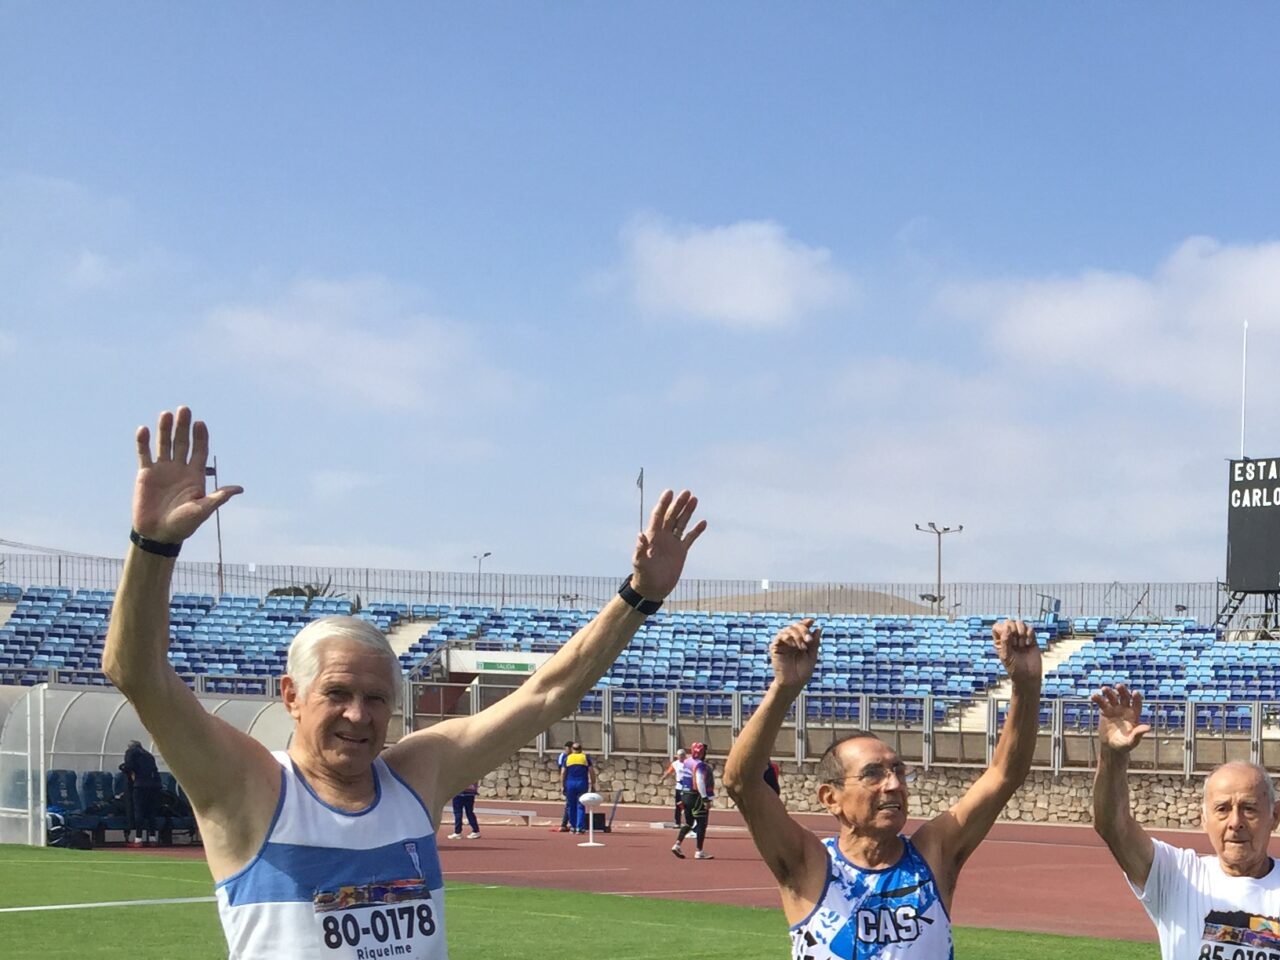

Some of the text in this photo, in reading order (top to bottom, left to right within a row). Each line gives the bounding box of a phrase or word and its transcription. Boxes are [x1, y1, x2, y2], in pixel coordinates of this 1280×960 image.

[323, 903, 436, 949] 80-0178
[857, 905, 920, 944] CAS
[356, 944, 412, 960] Riquelme
